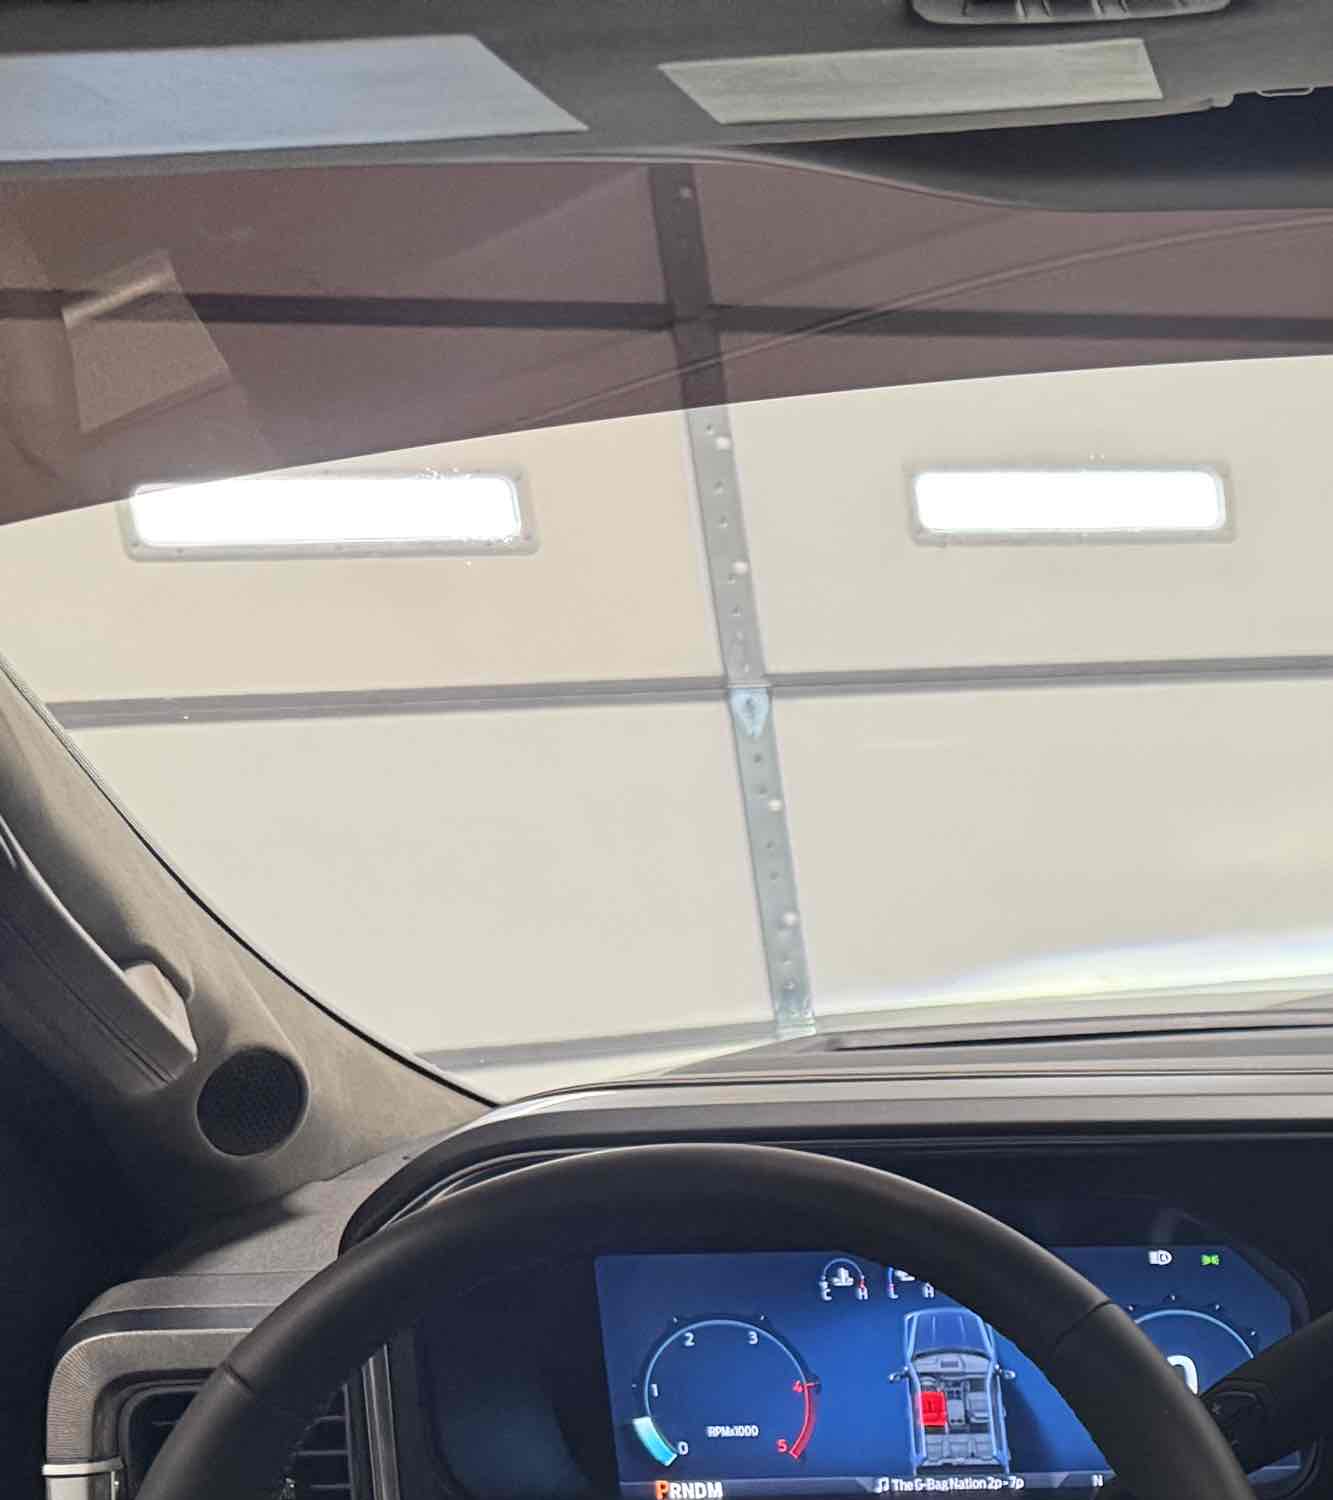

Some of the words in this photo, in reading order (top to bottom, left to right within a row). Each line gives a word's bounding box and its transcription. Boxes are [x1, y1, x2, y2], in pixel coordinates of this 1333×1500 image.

[684, 1333, 696, 1347] 2
[748, 1332, 759, 1345] 3
[650, 1383, 659, 1398] 1
[678, 1441, 689, 1456] 0
[776, 1439, 787, 1452] 5
[893, 1479, 913, 1491] The
[914, 1478, 950, 1493] G-Bag
[950, 1477, 987, 1490] Nation
